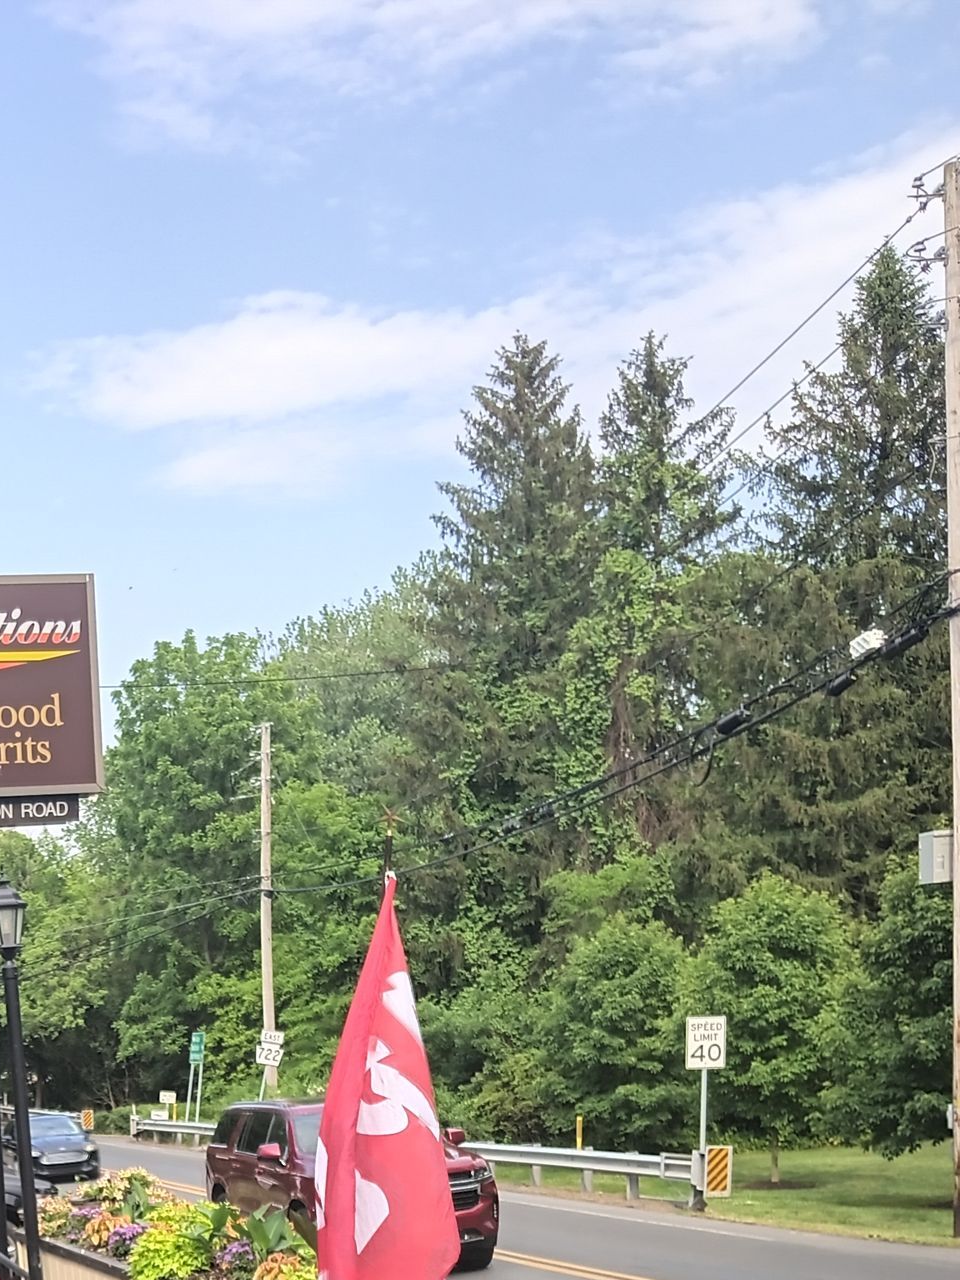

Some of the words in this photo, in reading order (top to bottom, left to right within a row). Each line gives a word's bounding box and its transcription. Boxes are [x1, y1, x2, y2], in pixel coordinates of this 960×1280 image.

[21, 801, 69, 818] ROAD
[690, 1022, 723, 1032] SPEED
[693, 1033, 719, 1042] LIMIT
[258, 1047, 280, 1062] 722
[690, 1043, 722, 1062] 40
